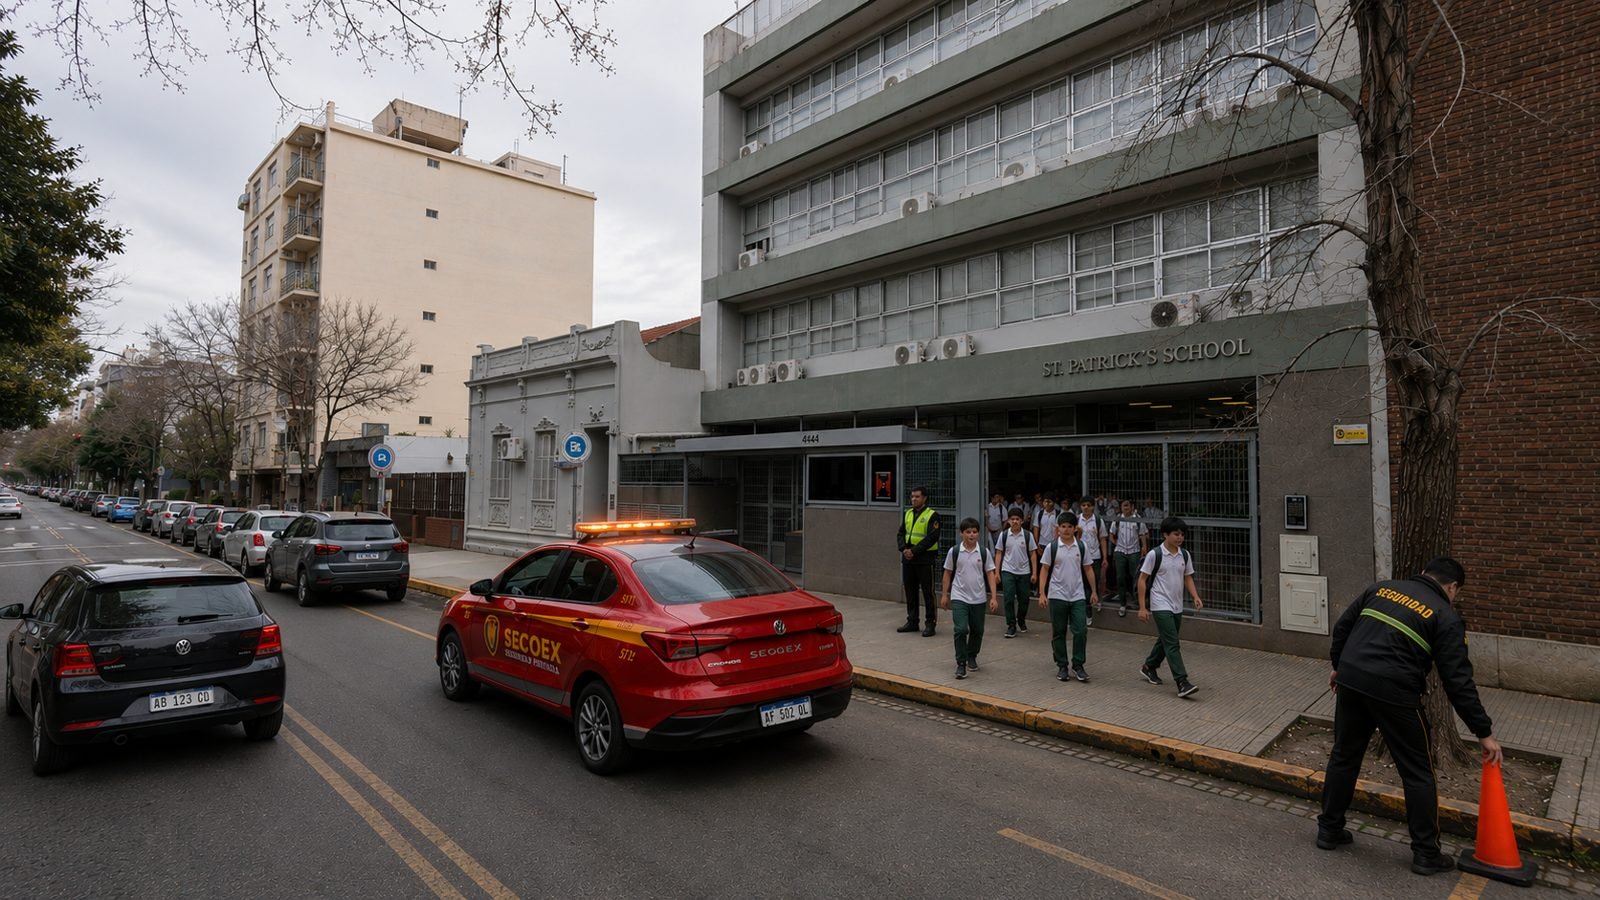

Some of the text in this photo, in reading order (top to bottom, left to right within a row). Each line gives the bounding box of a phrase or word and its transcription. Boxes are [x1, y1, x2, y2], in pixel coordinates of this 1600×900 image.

[1042, 338, 1251, 378] ST. PATRICK'S SCHOOL
[802, 434, 819, 444] 4444
[1375, 588, 1433, 618] SEGURIDAD
[504, 627, 562, 664] SECOEX
[153, 697, 167, 709] AB
[173, 693, 192, 706] 123
[197, 691, 210, 703] CD
[764, 711, 775, 723] AF
[779, 706, 795, 720] 502
